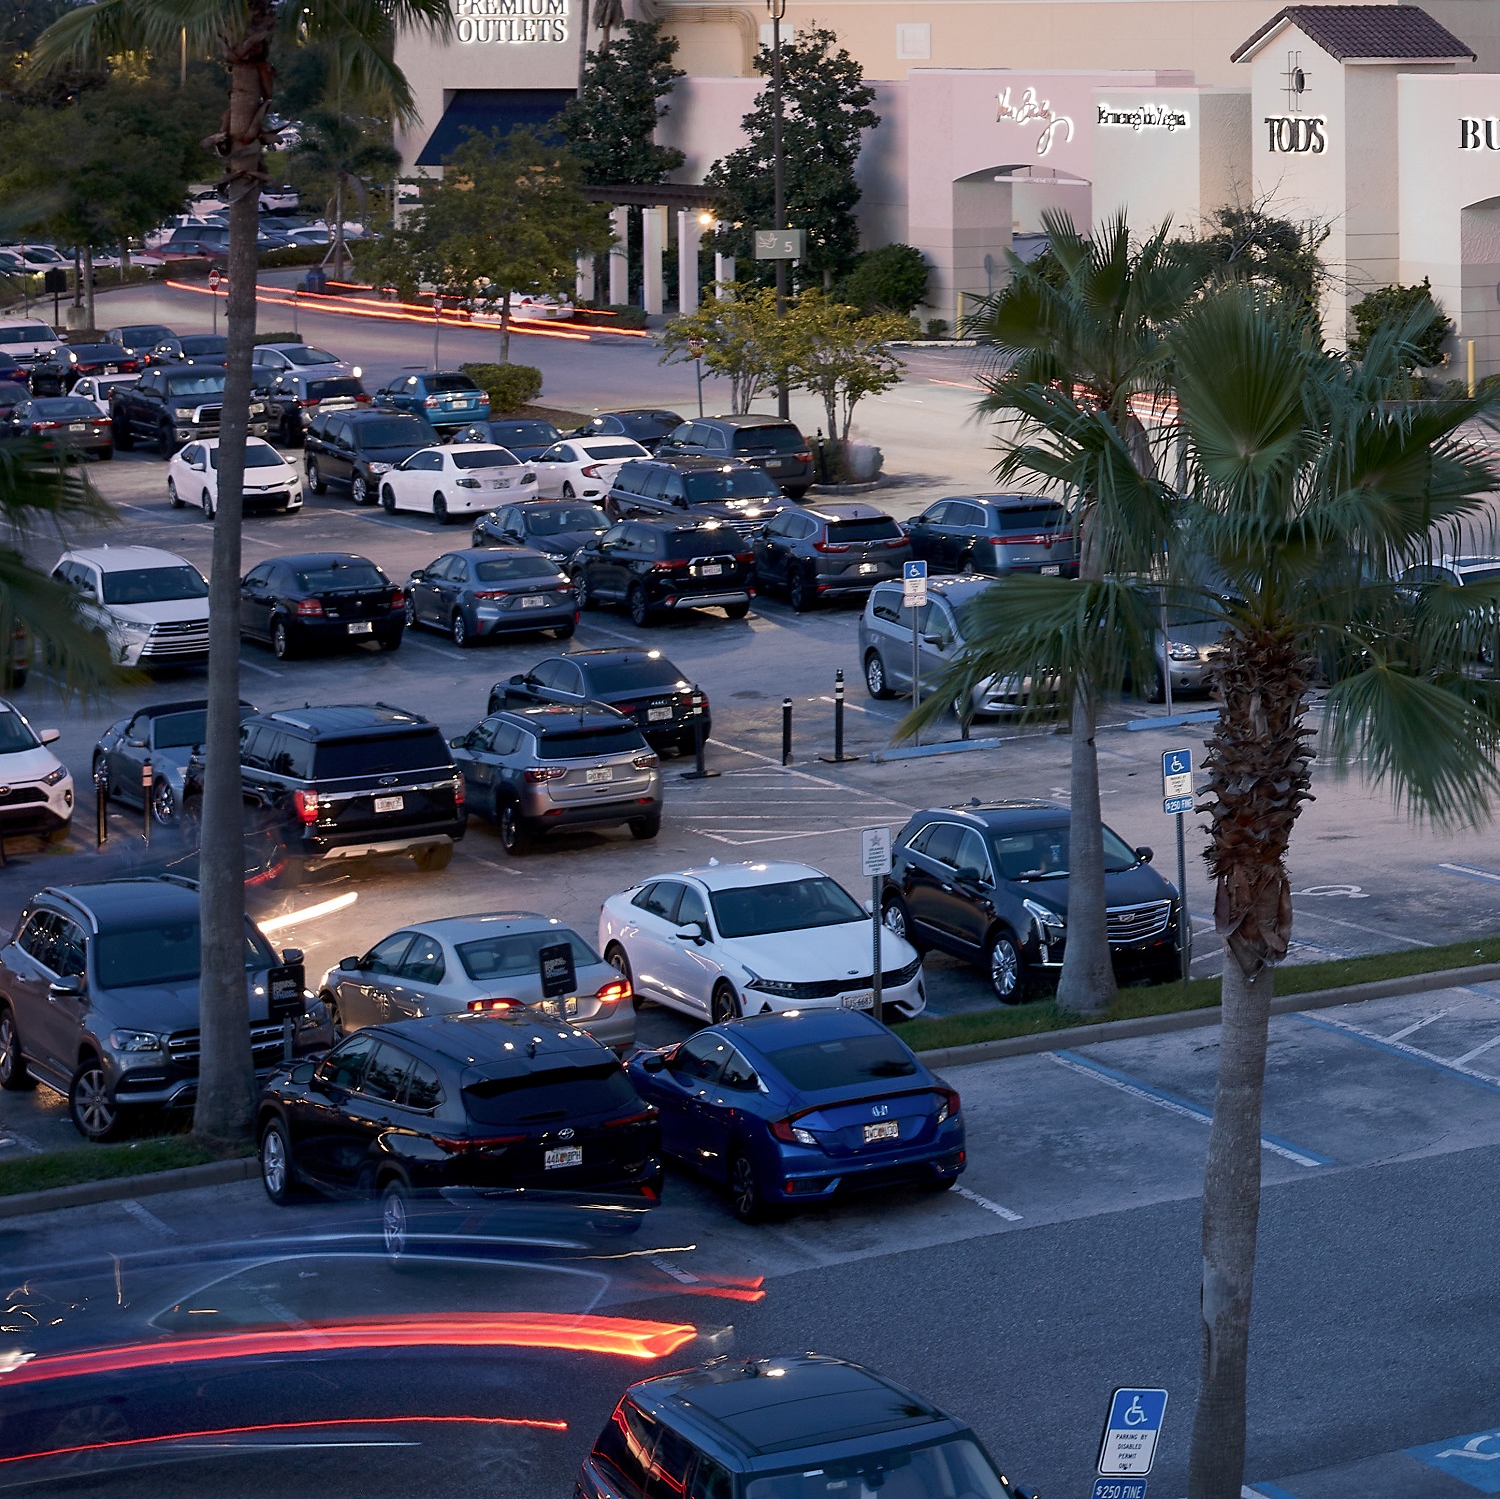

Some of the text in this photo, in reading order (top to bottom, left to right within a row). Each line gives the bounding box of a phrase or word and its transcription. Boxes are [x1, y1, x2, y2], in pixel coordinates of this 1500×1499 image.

[457, 18, 566, 42] OUTLETS
[784, 241, 793, 252] 5
[1096, 1485, 1142, 1499] $250 FINE
